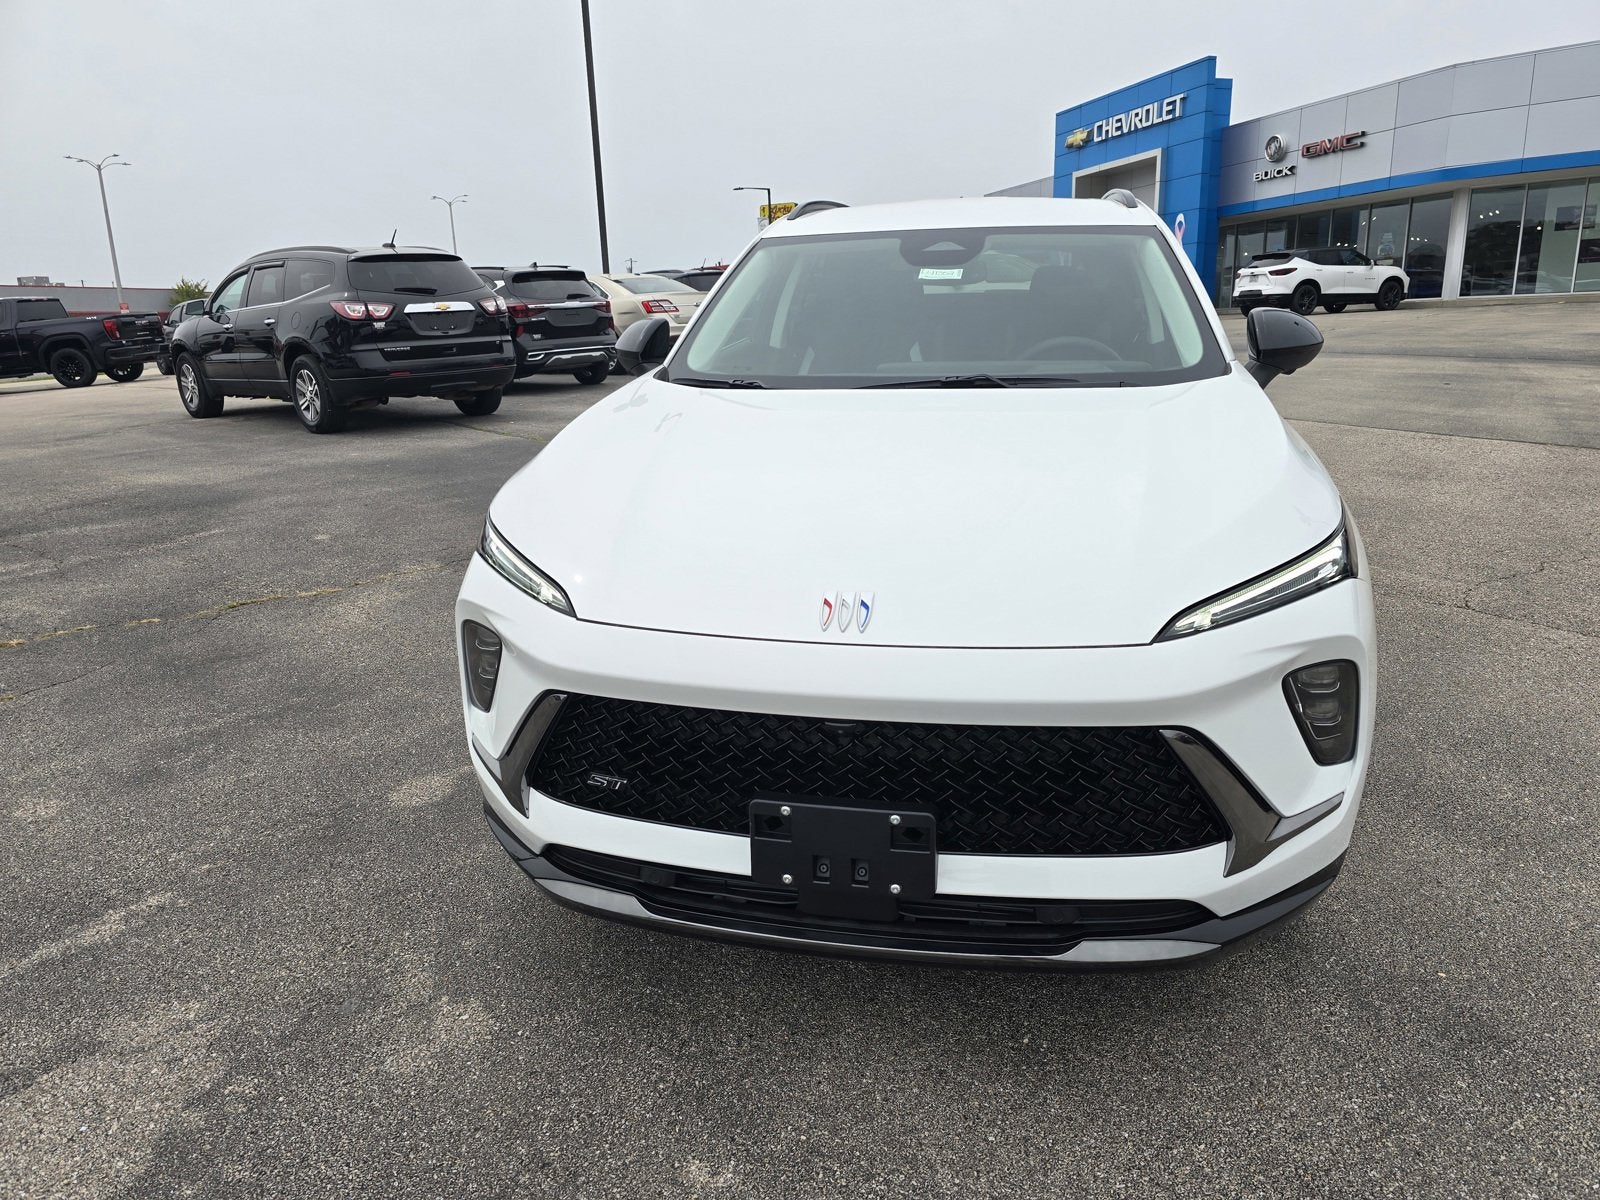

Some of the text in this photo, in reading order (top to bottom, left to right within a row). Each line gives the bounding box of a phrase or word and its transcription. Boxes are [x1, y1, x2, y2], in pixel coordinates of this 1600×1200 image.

[1093, 93, 1186, 142] CHEVROLET
[1302, 131, 1366, 158] GMC
[1253, 165, 1296, 182] BUICK
[587, 772, 628, 790] ST
